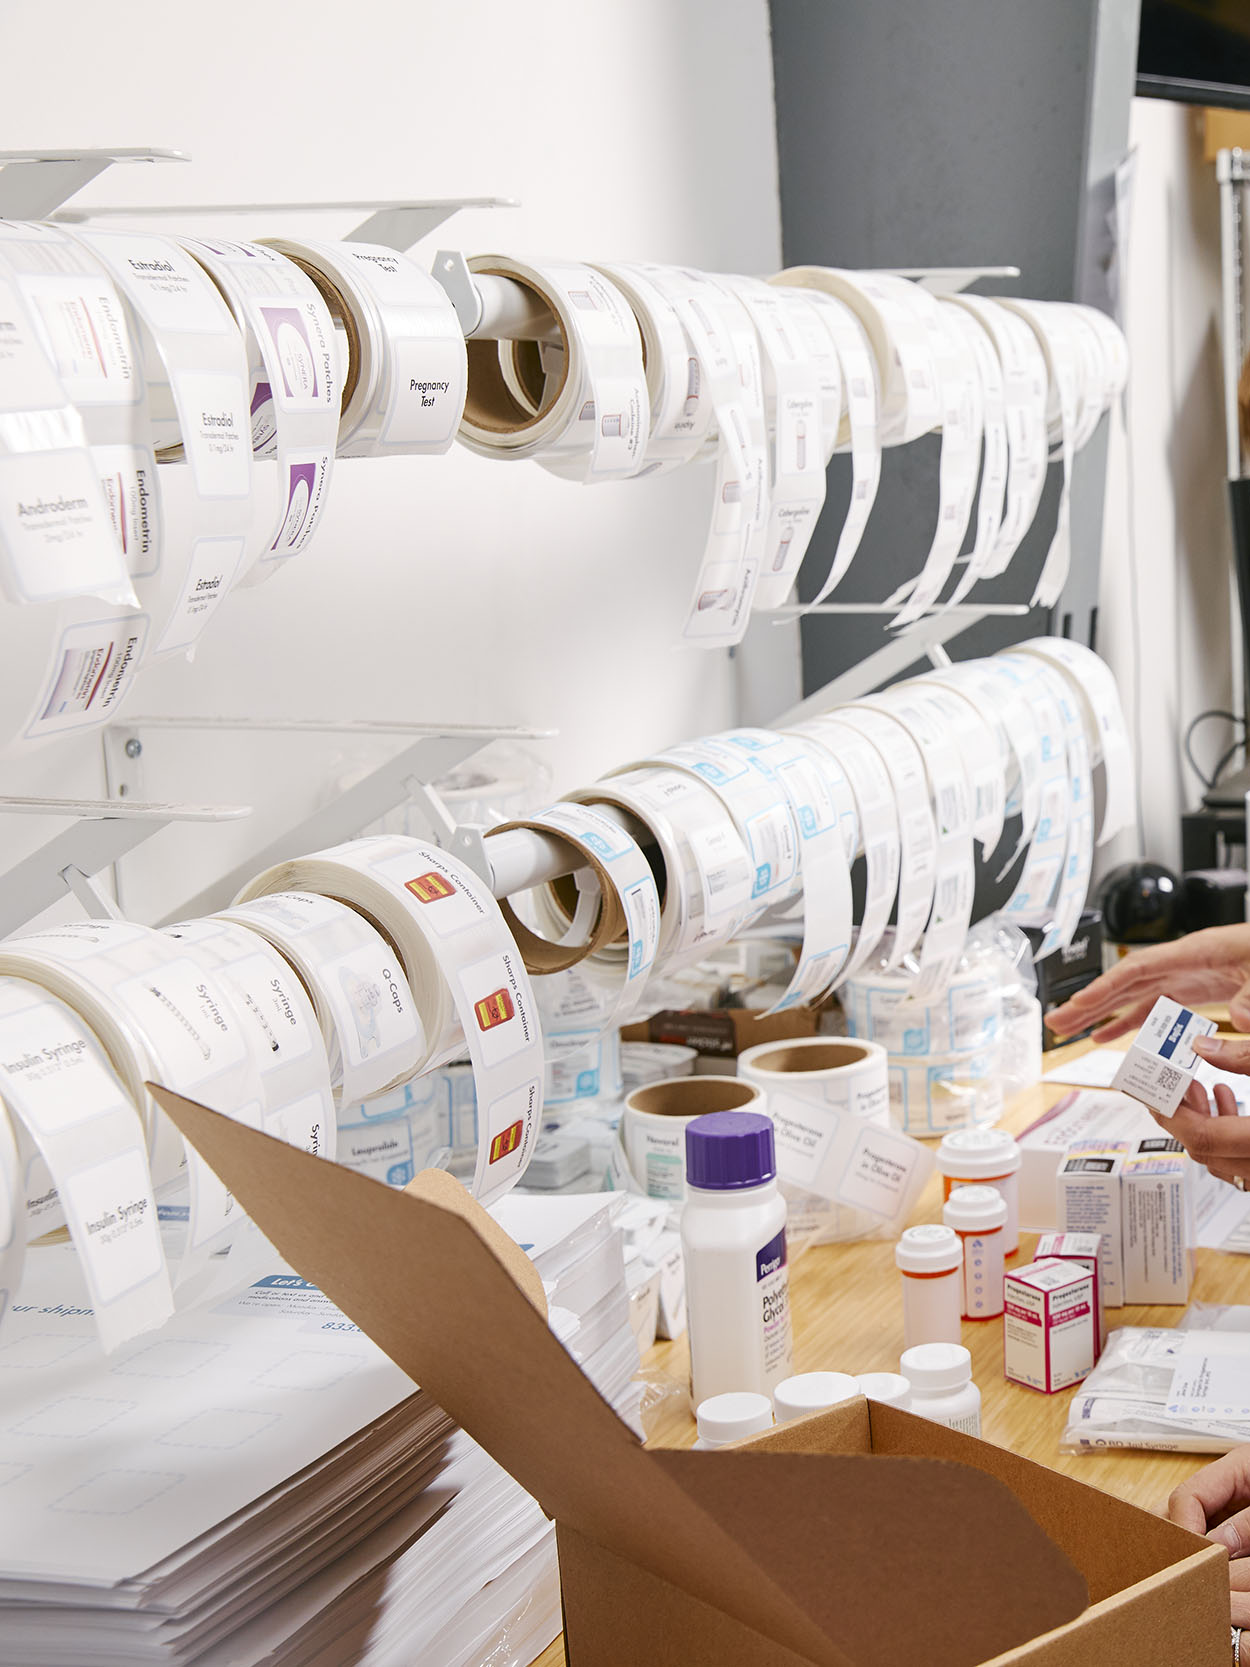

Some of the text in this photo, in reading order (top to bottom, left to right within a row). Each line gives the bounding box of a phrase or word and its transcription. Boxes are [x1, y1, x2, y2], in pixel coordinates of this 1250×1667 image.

[128, 258, 175, 273] Estradiol
[306, 303, 333, 404] Synera Patches
[409, 378, 450, 394] Pregnancy
[420, 396, 436, 408] Test
[201, 412, 235, 429] Estradiol
[310, 456, 328, 504] Synera
[17, 495, 89, 518] Androderm
[135, 470, 150, 553] Endometrin
[195, 575, 224, 592] Estradiol
[102, 636, 138, 709] Endometrin
[418, 849, 486, 915] Sharps Container
[195, 983, 229, 1033] Syringe
[270, 978, 298, 1026] Syringe
[381, 967, 404, 1014] Q-Caps
[501, 955, 531, 1043] Sharps Container
[2, 1051, 43, 1075] Insulin
[42, 1038, 88, 1062] Syringe
[526, 1085, 536, 1122] Sharps
[85, 1211, 118, 1236] Insulin
[117, 1197, 148, 1222] Syringe
[271, 1278, 303, 1287] Let's
[760, 1257, 782, 1276] Perrigo
[1052, 1284, 1090, 1302] Progesterone
[1108, 1440, 1124, 1448] BD
